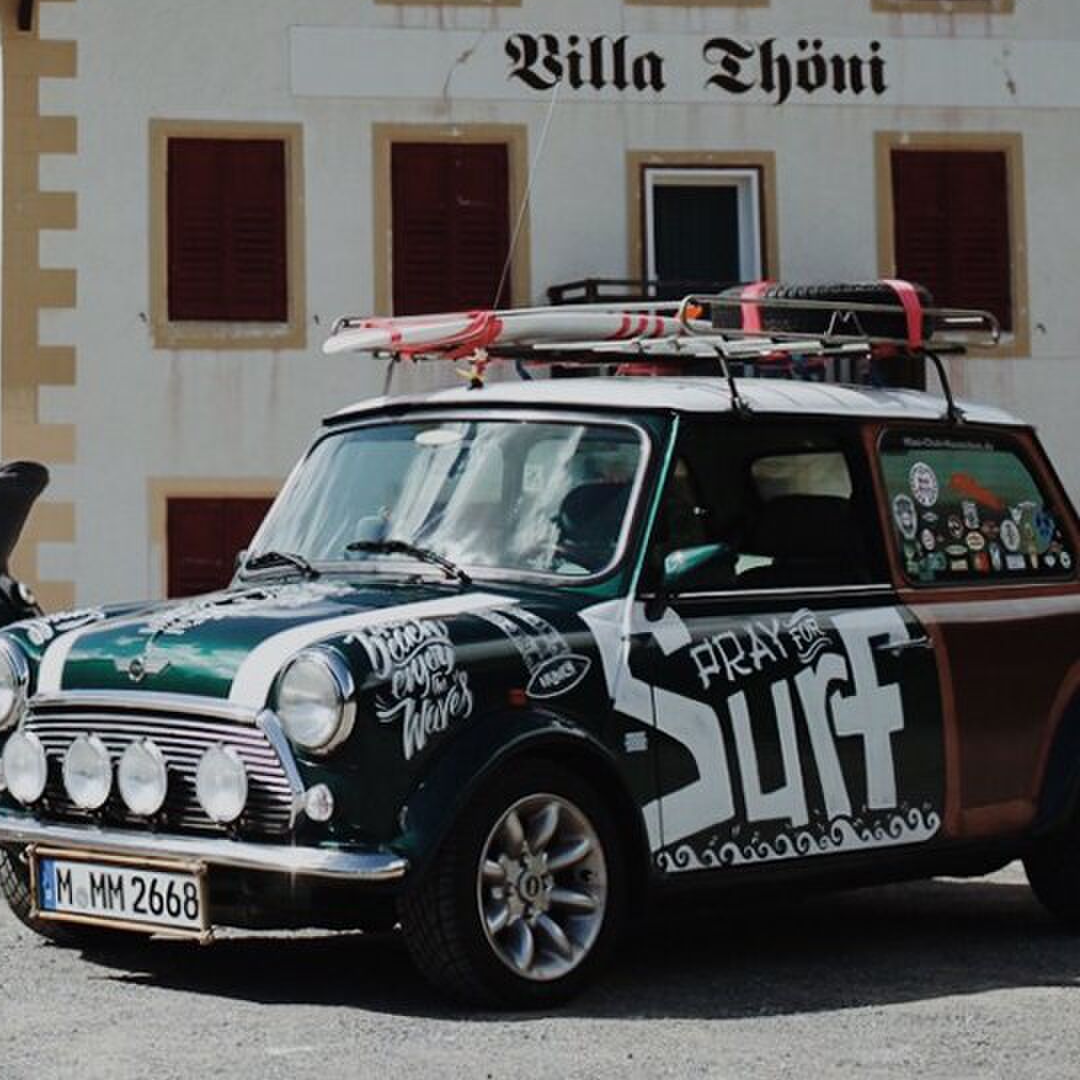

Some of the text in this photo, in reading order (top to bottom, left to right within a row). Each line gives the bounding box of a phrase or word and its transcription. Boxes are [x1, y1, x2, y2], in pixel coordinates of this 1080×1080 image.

[505, 33, 887, 106] Villa Thöni
[689, 619, 825, 690] PRAY FOR
[56, 867, 200, 921] M MM 2668
